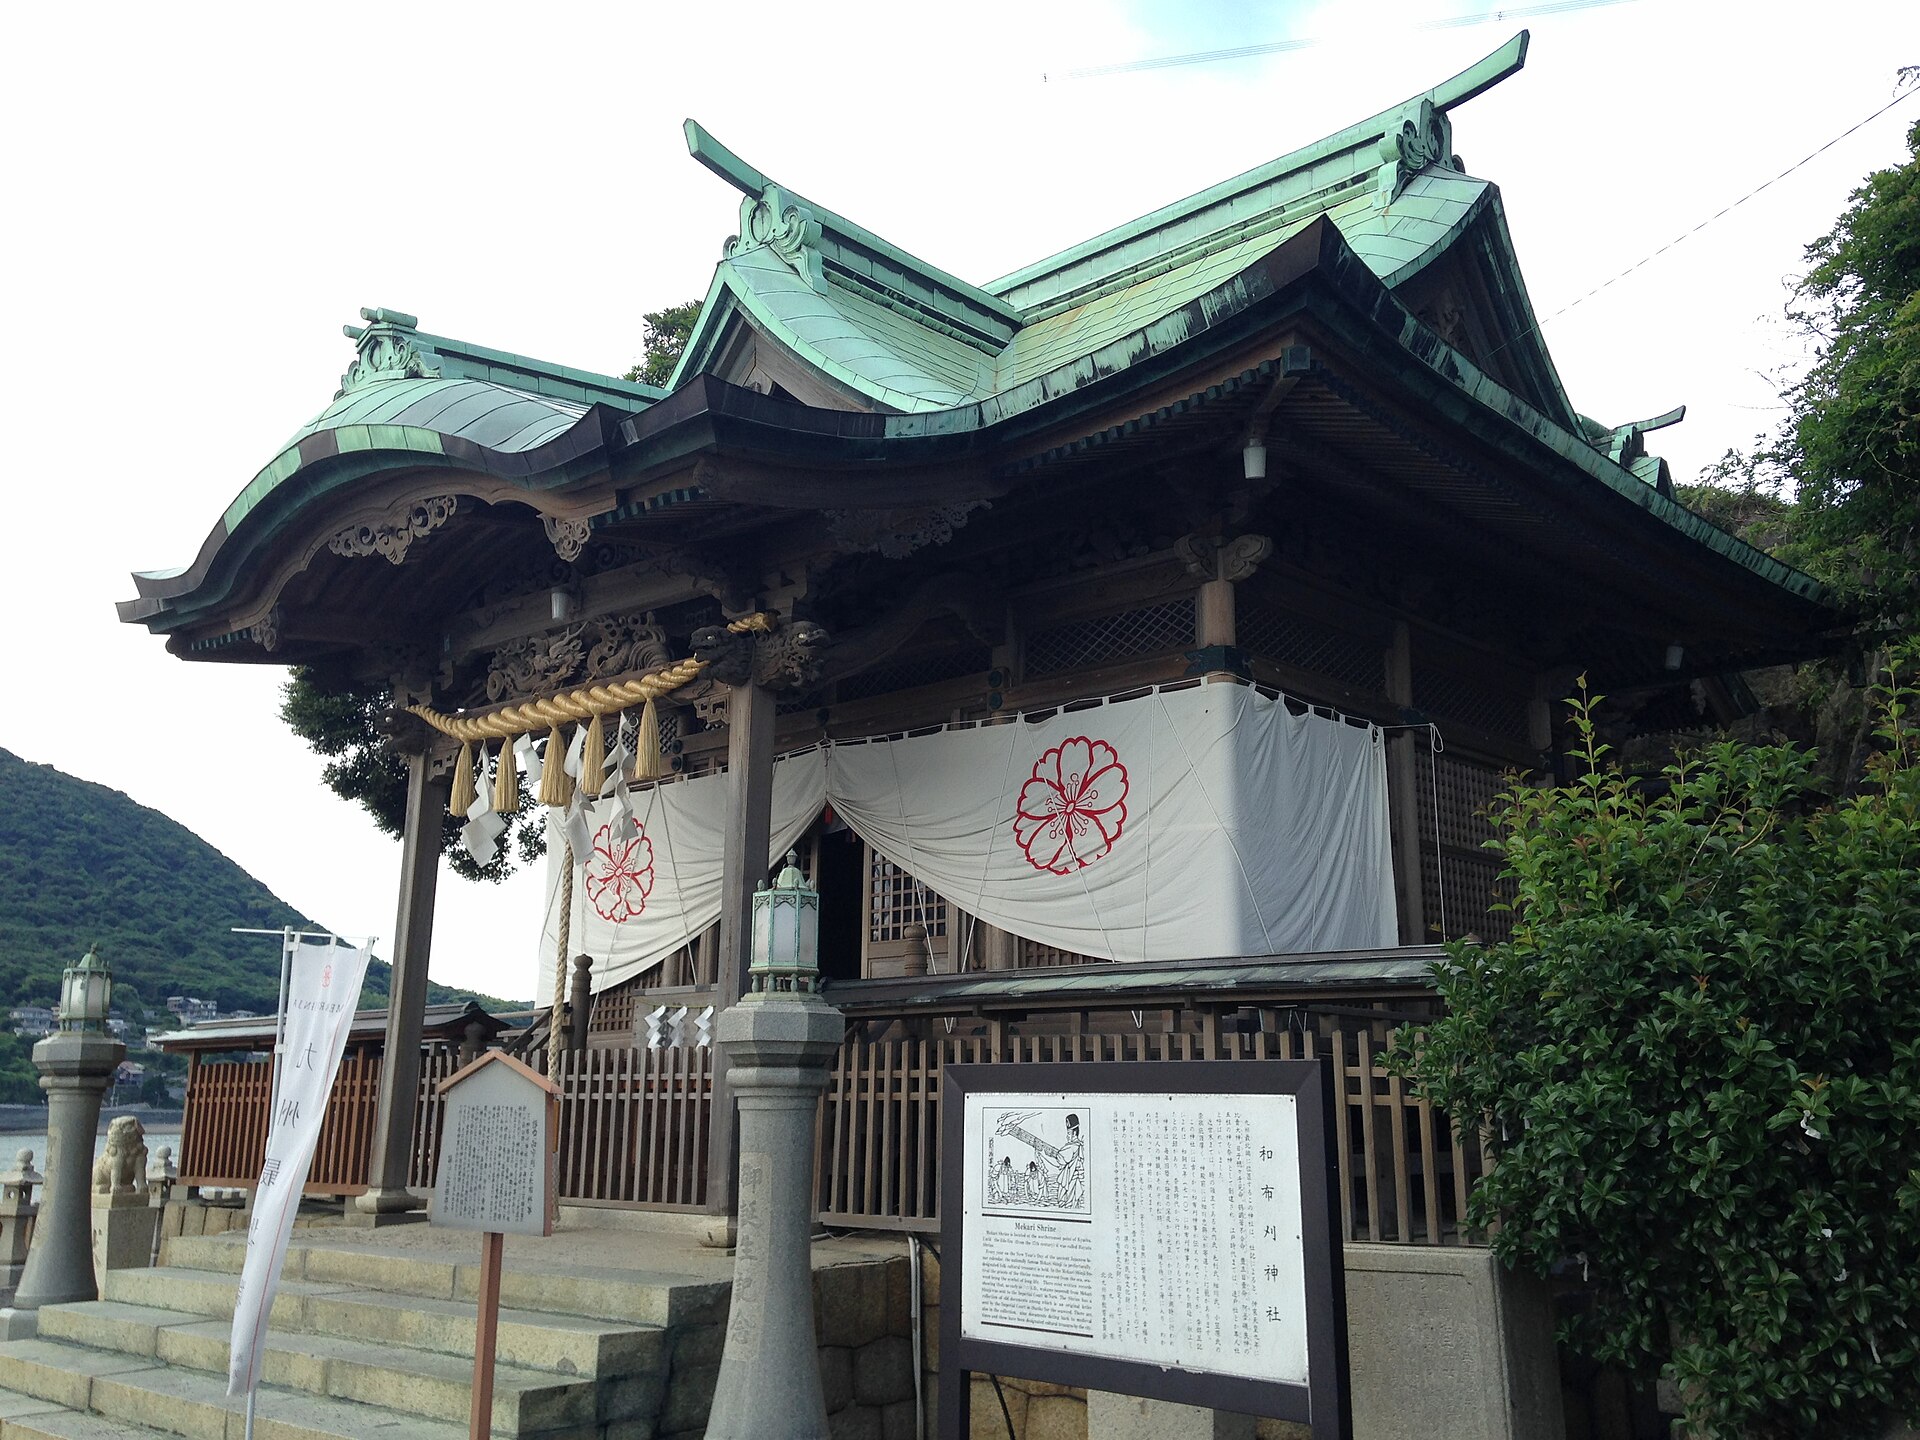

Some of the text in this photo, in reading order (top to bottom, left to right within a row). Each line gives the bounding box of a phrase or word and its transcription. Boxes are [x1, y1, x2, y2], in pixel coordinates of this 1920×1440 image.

[1014, 1222, 1056, 1232] Mekari Shrine
[1259, 1146, 1282, 1323] 和布刈神社
